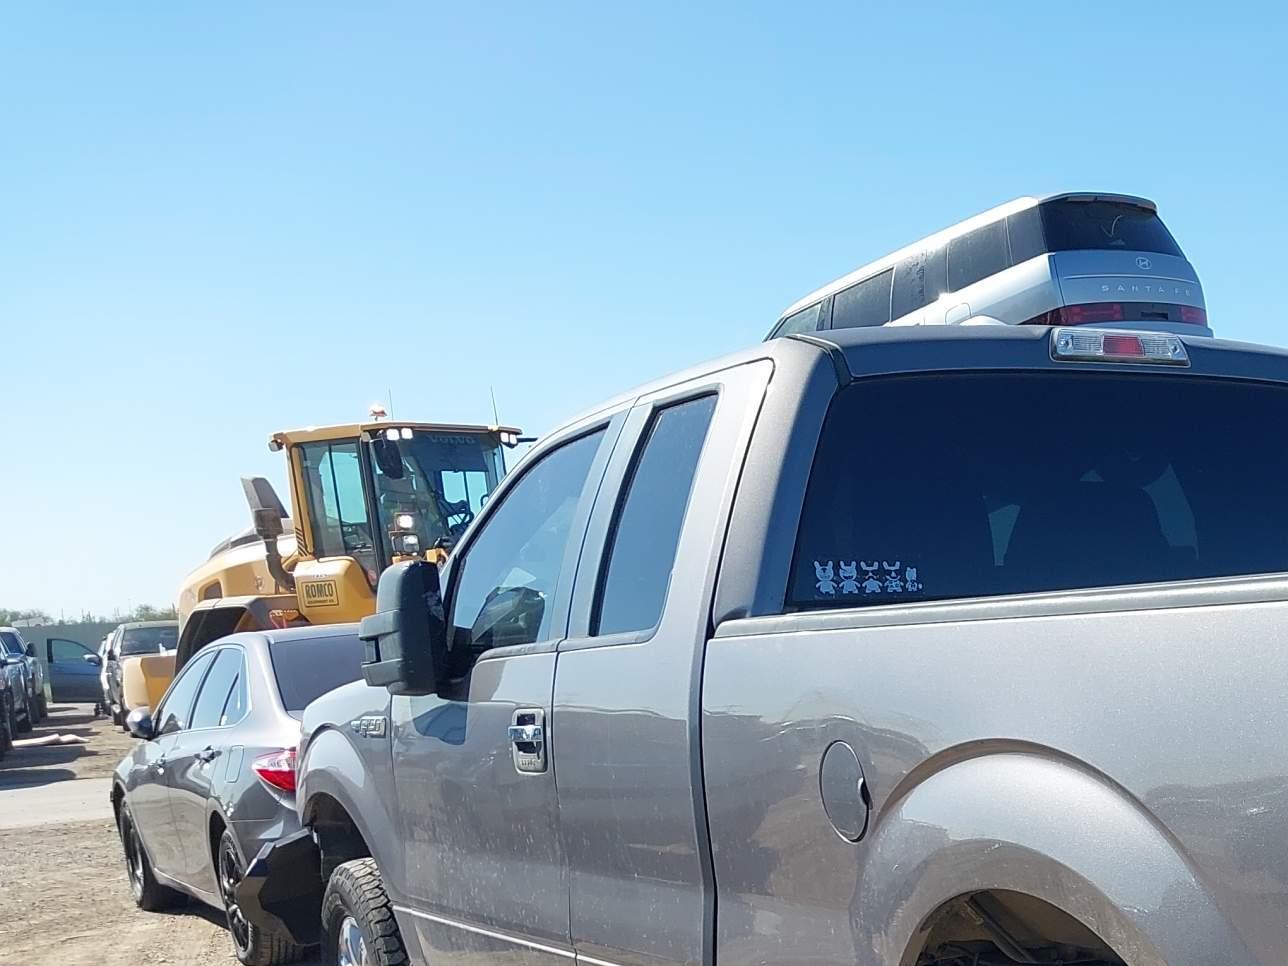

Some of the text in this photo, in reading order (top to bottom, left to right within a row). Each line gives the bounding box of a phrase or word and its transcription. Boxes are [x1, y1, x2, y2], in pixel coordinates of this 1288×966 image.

[1102, 285, 1191, 297] SANTA FE
[304, 583, 334, 598] ROMCO
